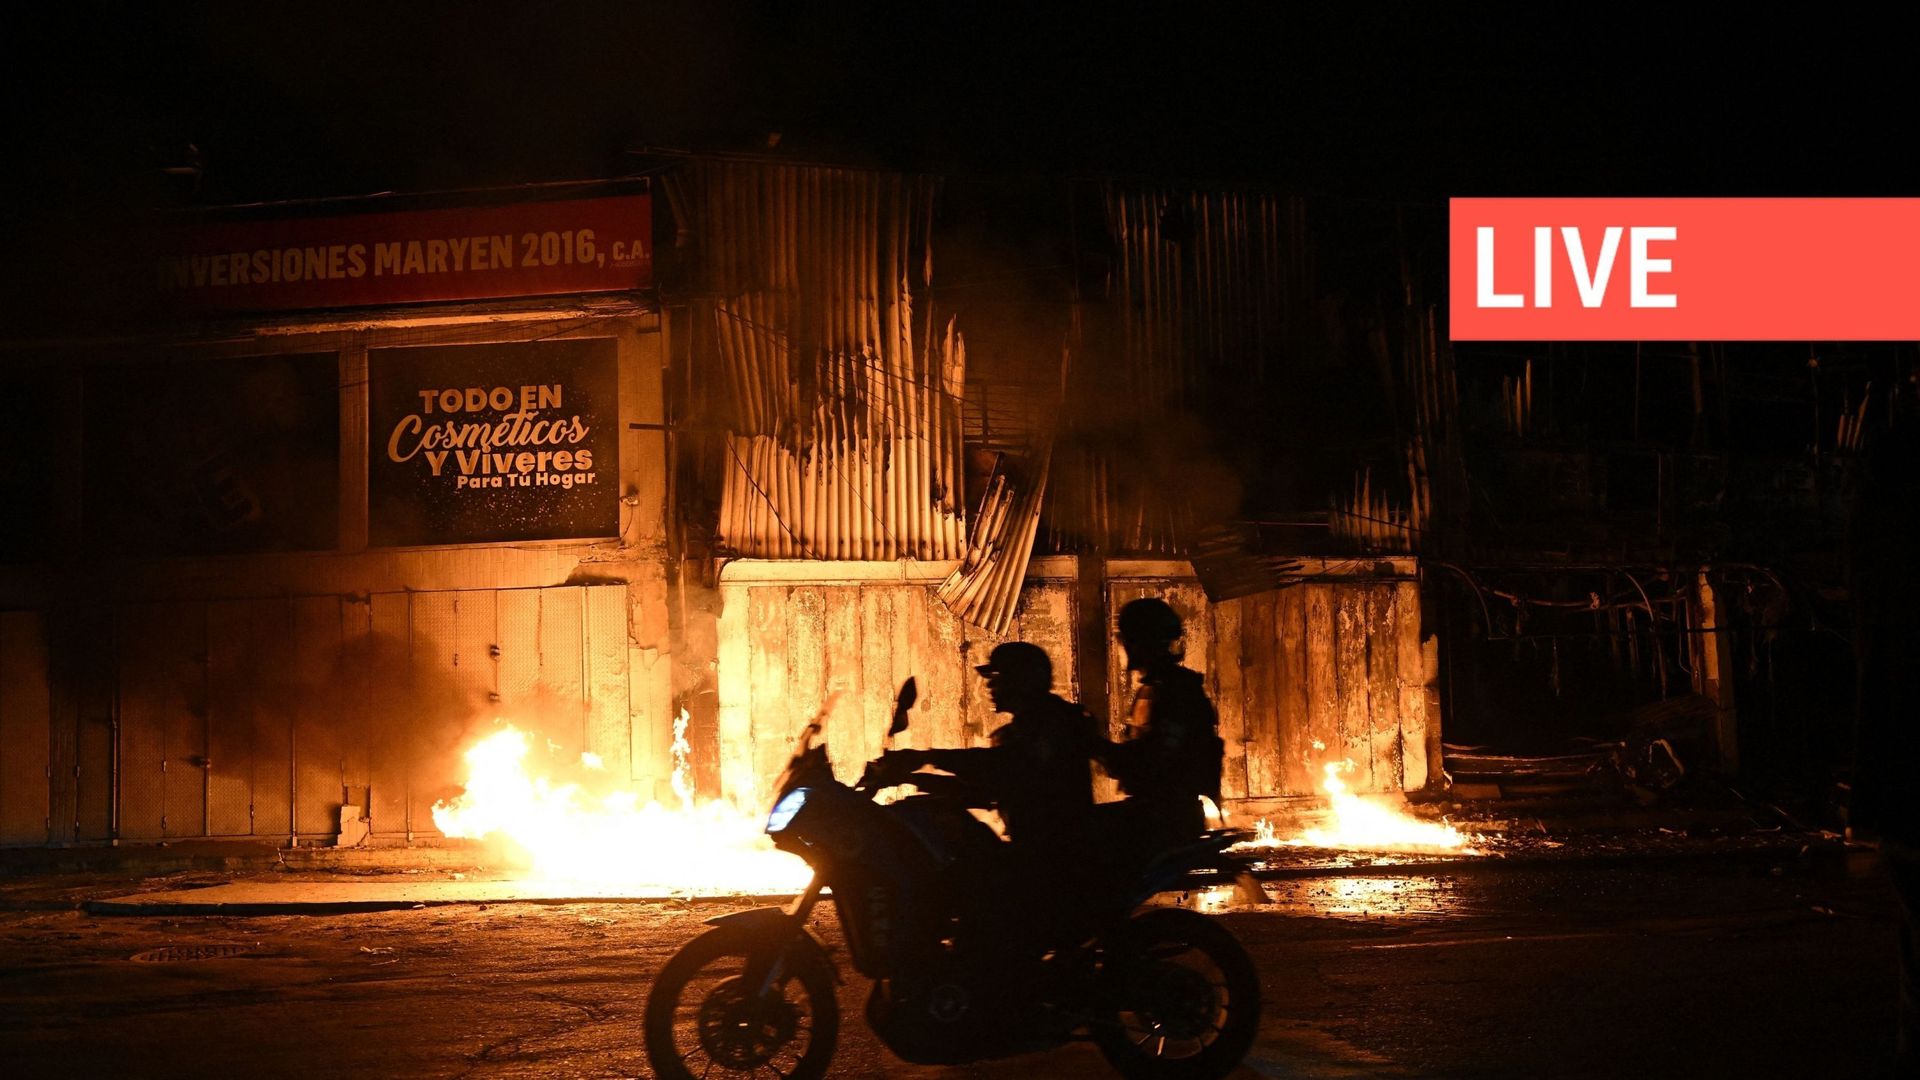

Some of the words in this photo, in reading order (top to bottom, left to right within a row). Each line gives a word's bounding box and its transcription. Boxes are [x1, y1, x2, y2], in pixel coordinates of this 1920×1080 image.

[374, 235, 513, 277] MARYEN
[521, 228, 605, 269] 2016,
[612, 239, 650, 261] C.A.
[419, 387, 513, 414] TODO
[521, 384, 562, 410] EN
[424, 451, 449, 477] Y
[457, 475, 503, 489] Para
[535, 472, 596, 490] Hogar
